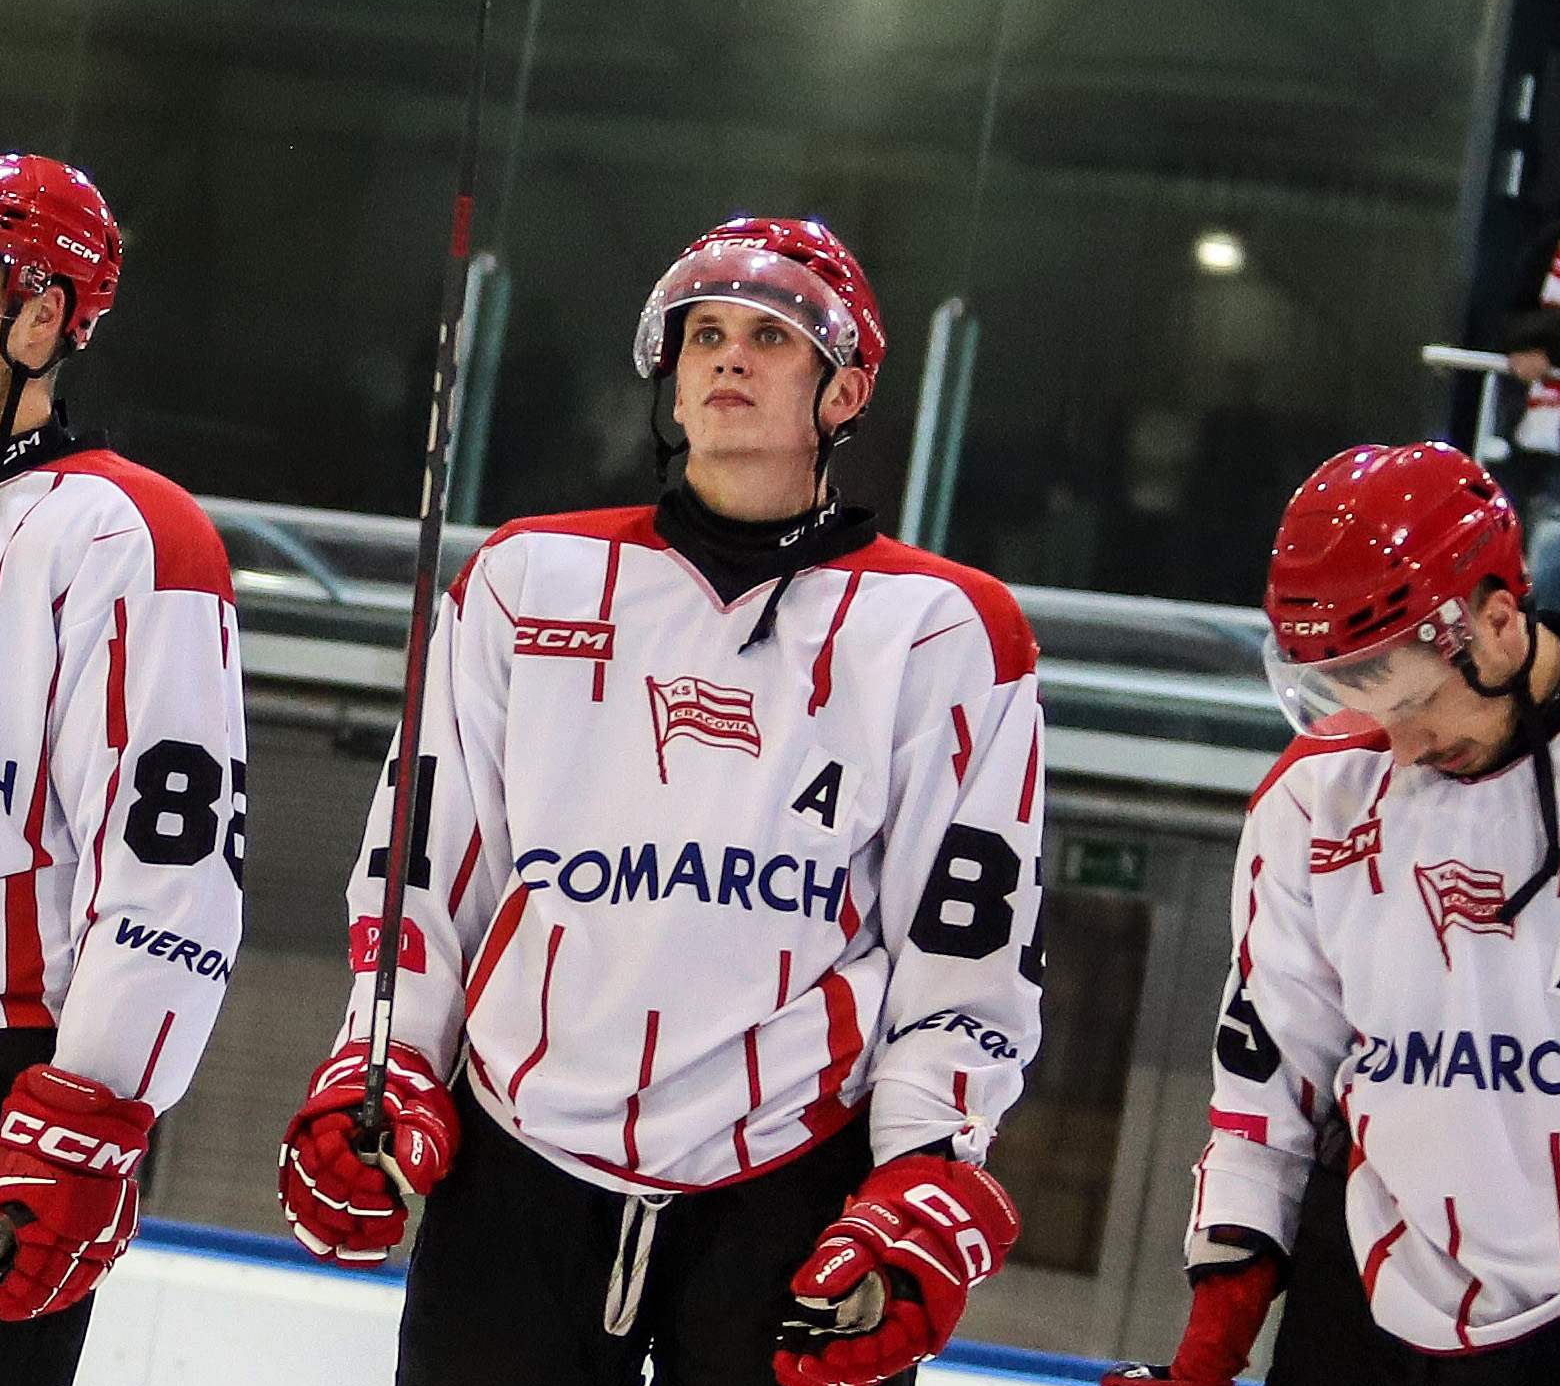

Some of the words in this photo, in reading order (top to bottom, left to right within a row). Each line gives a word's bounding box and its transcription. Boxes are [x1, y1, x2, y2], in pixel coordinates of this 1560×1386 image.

[56, 233, 102, 264] CCM
[513, 626, 611, 652] CCM
[1281, 620, 1331, 637] CCM
[669, 684, 693, 699] KS
[673, 707, 752, 734] CRACOVIA
[794, 761, 844, 828] A
[516, 840, 851, 923] COMARCH
[0, 1110, 143, 1175] CCM
[411, 1128, 424, 1166] CCM
[902, 1182, 994, 1289] CC
